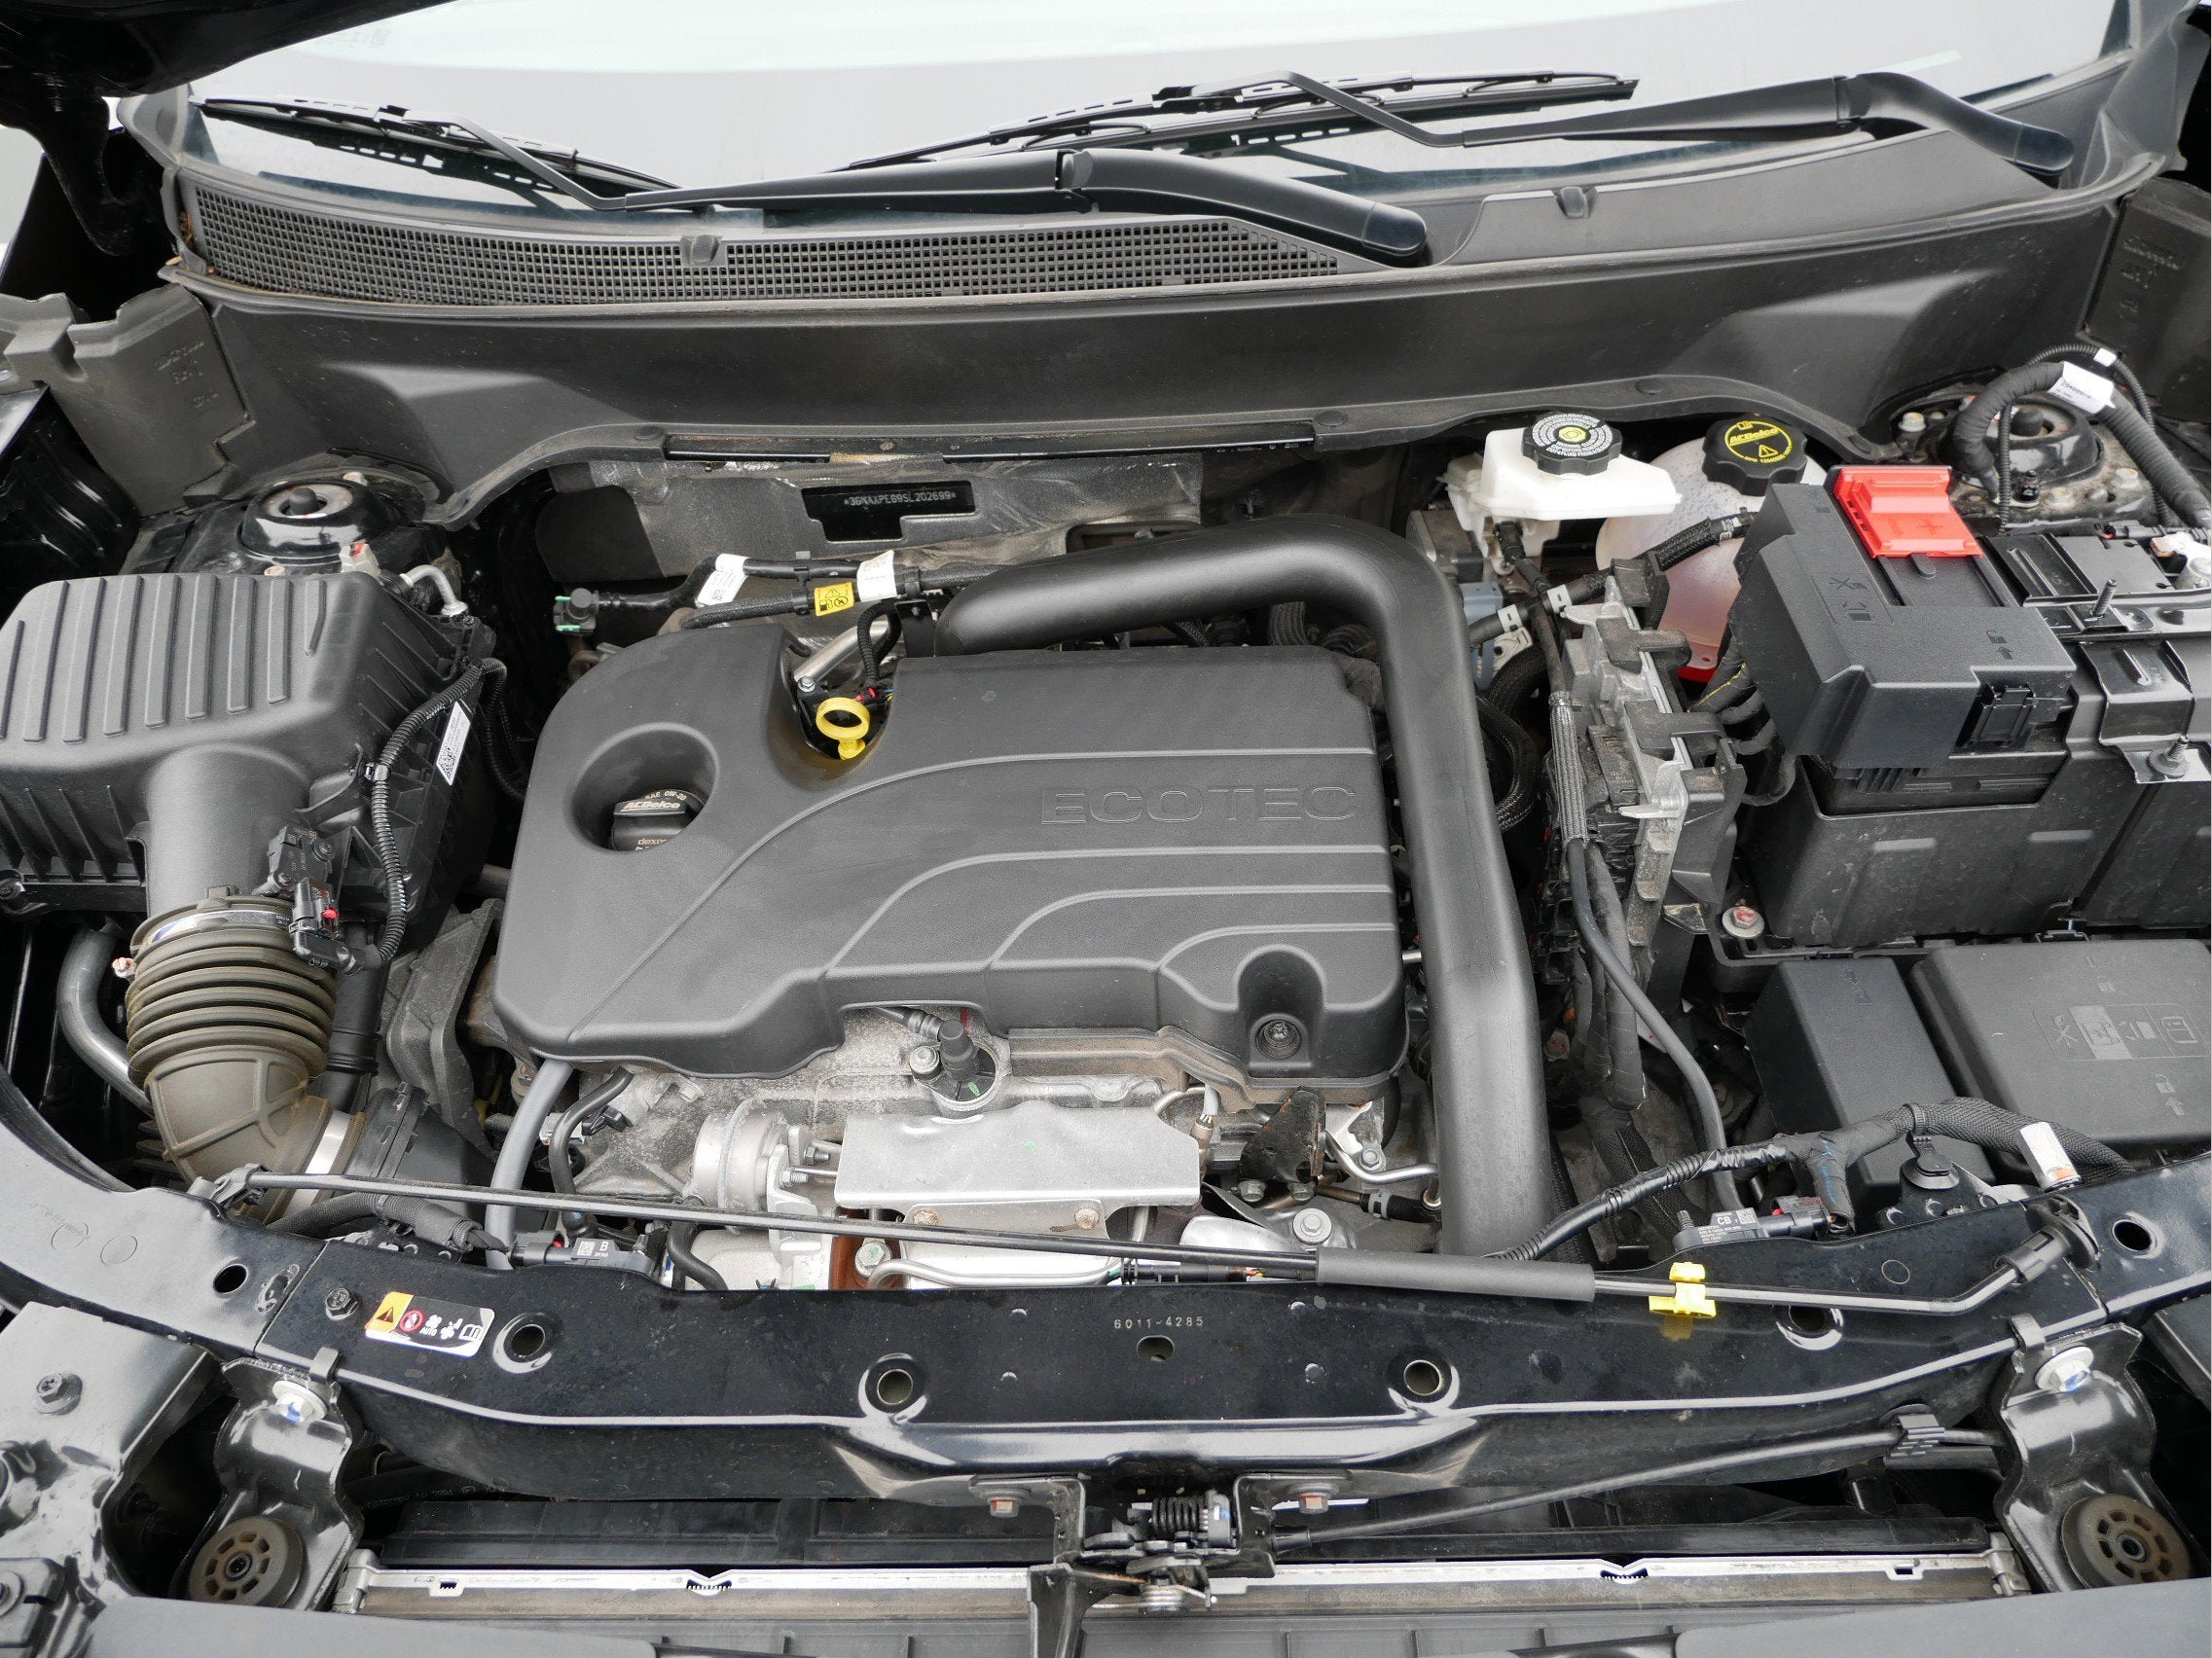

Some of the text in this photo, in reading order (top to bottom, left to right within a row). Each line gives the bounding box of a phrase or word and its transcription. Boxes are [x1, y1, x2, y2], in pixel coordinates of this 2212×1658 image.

[665, 790, 687, 801] 0W-20
[624, 801, 681, 810] ACDelco
[1041, 785, 1356, 824] ECOTEC
[1717, 1216, 1731, 1226] CB
[599, 1242, 609, 1251] B
[1113, 1316, 1204, 1329] 6011-4285
[419, 1326, 438, 1336] AUTO
